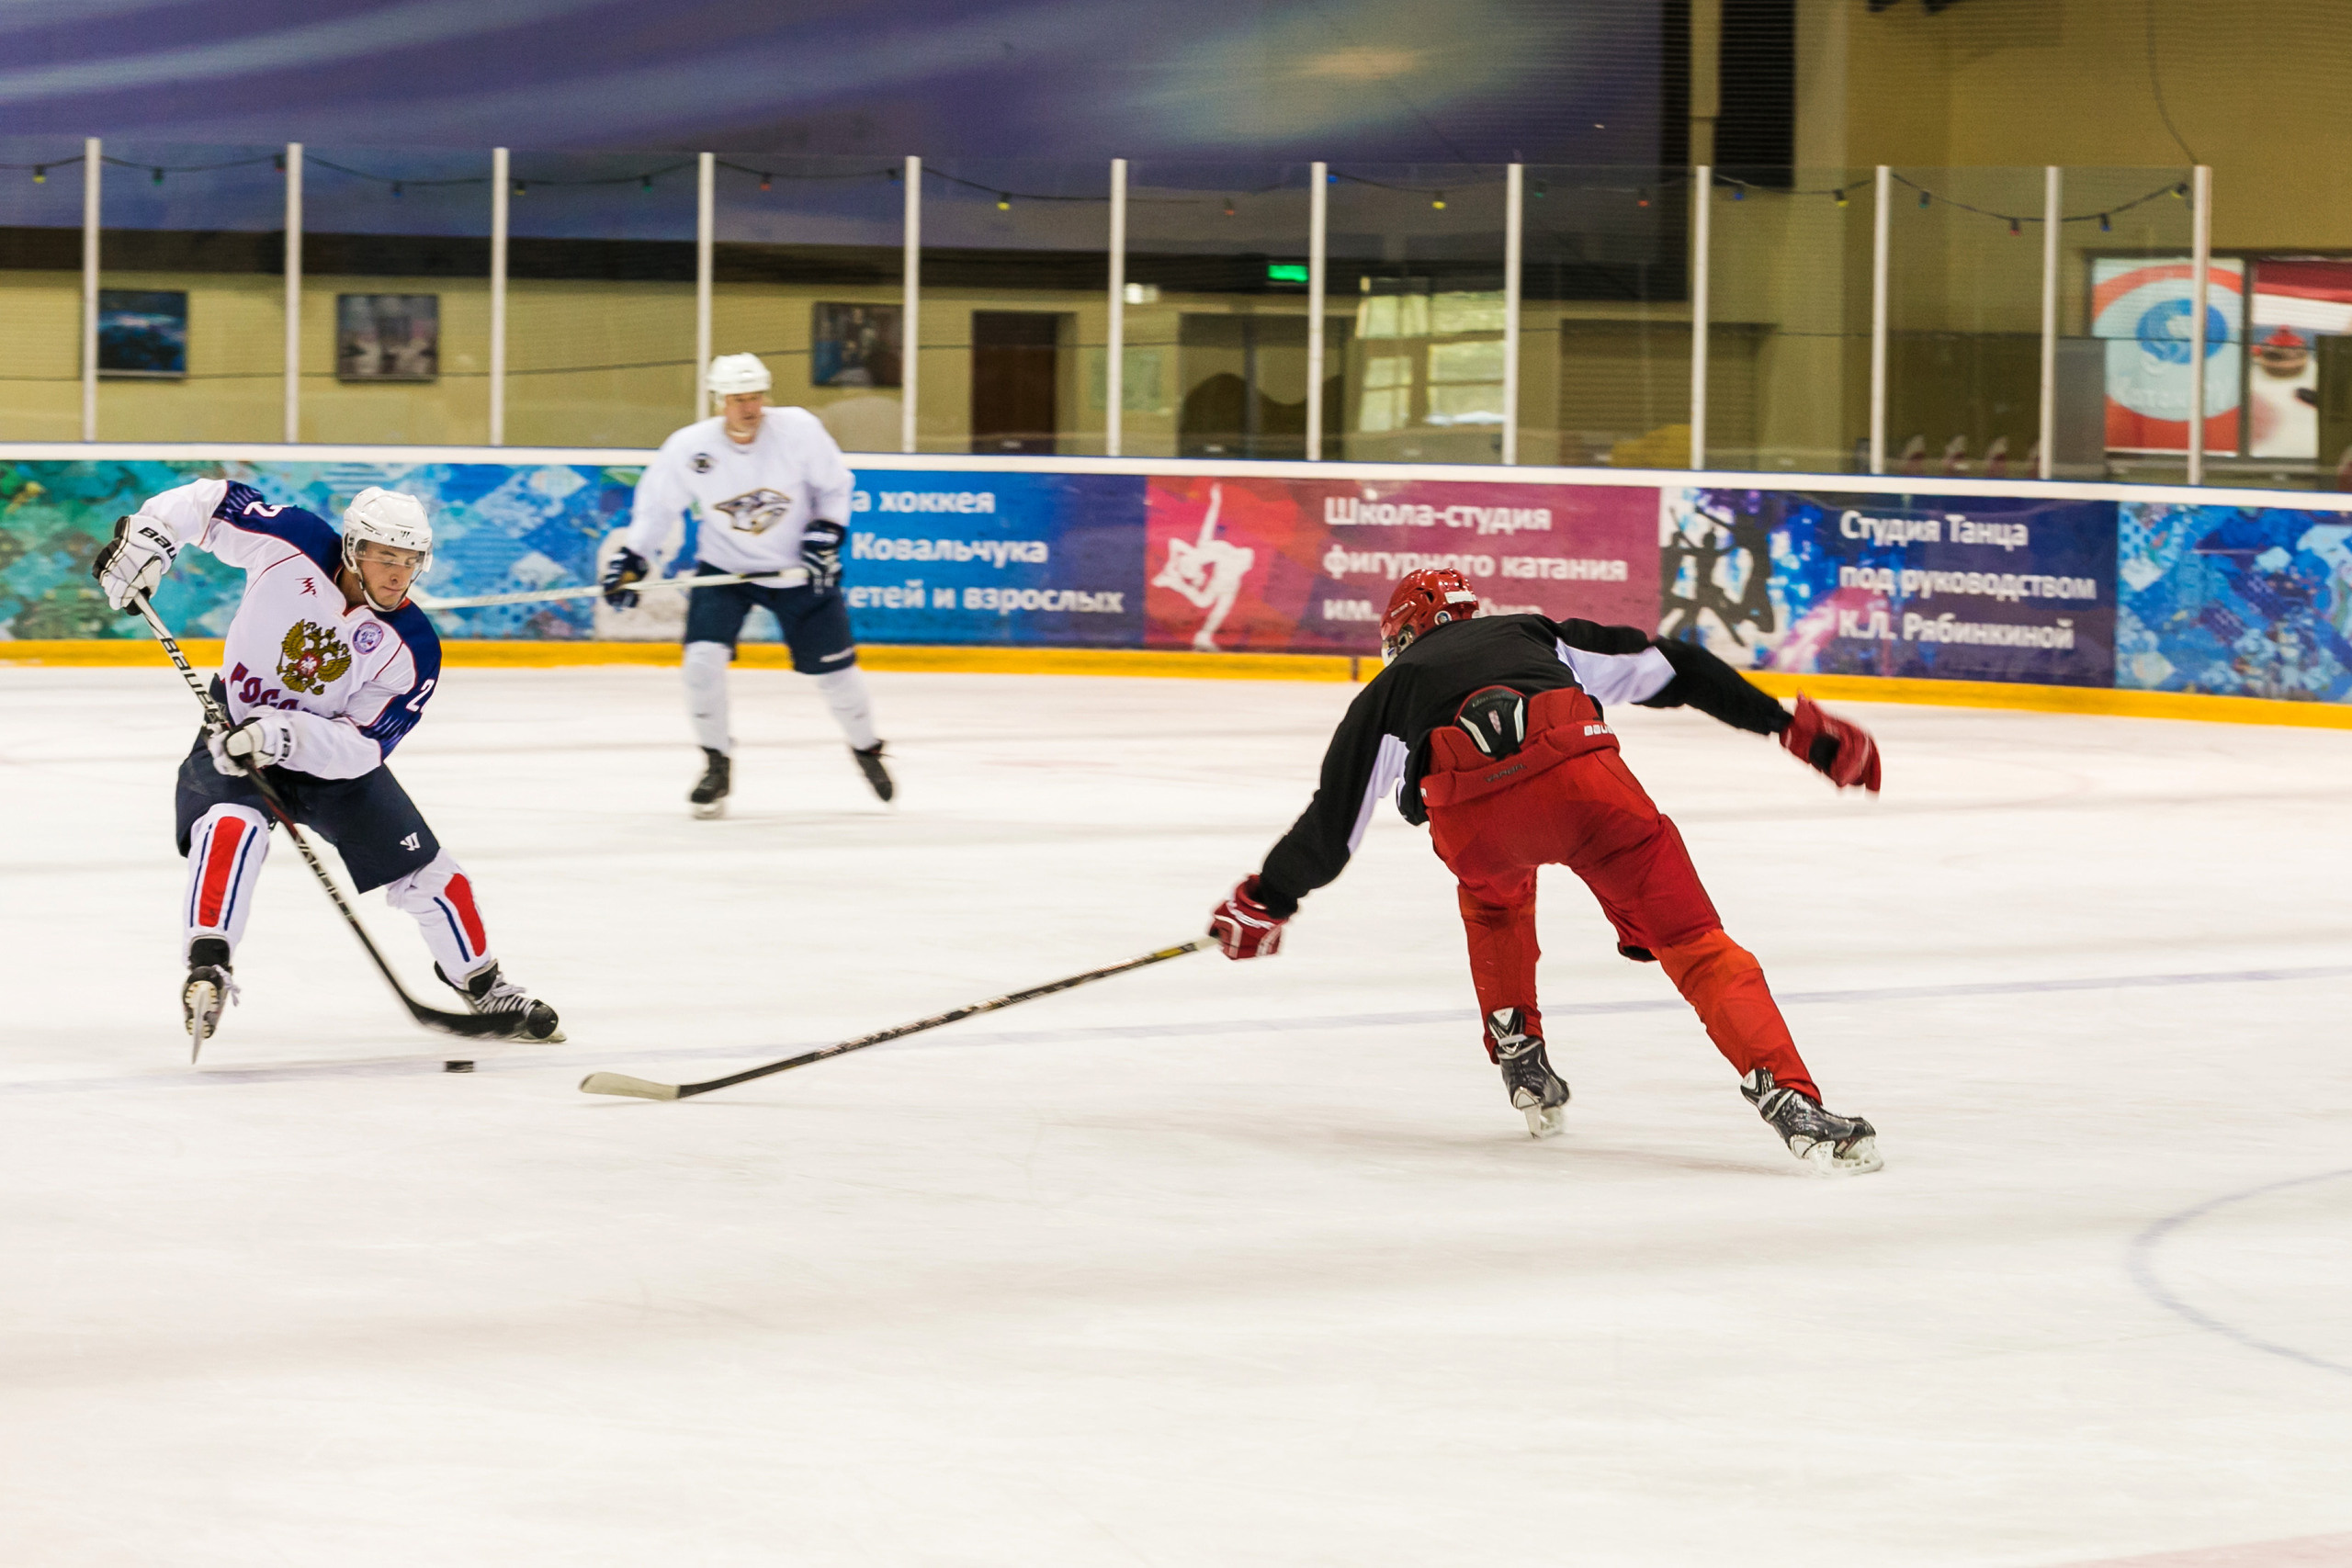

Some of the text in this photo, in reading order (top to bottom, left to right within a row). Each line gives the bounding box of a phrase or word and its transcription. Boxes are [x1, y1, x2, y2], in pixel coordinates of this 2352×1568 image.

[878, 491, 996, 513] хоккея
[1324, 496, 1552, 535] Школа-студия
[1840, 510, 2029, 551] Студия Танца
[851, 532, 1049, 569] Ковальчука
[1323, 544, 1628, 581] фигурного катания
[843, 580, 926, 609] етей
[933, 587, 956, 609] и
[964, 587, 1125, 616] взрослых
[1839, 566, 2097, 602] под руководством
[1903, 612, 2075, 649] Рябинкиной
